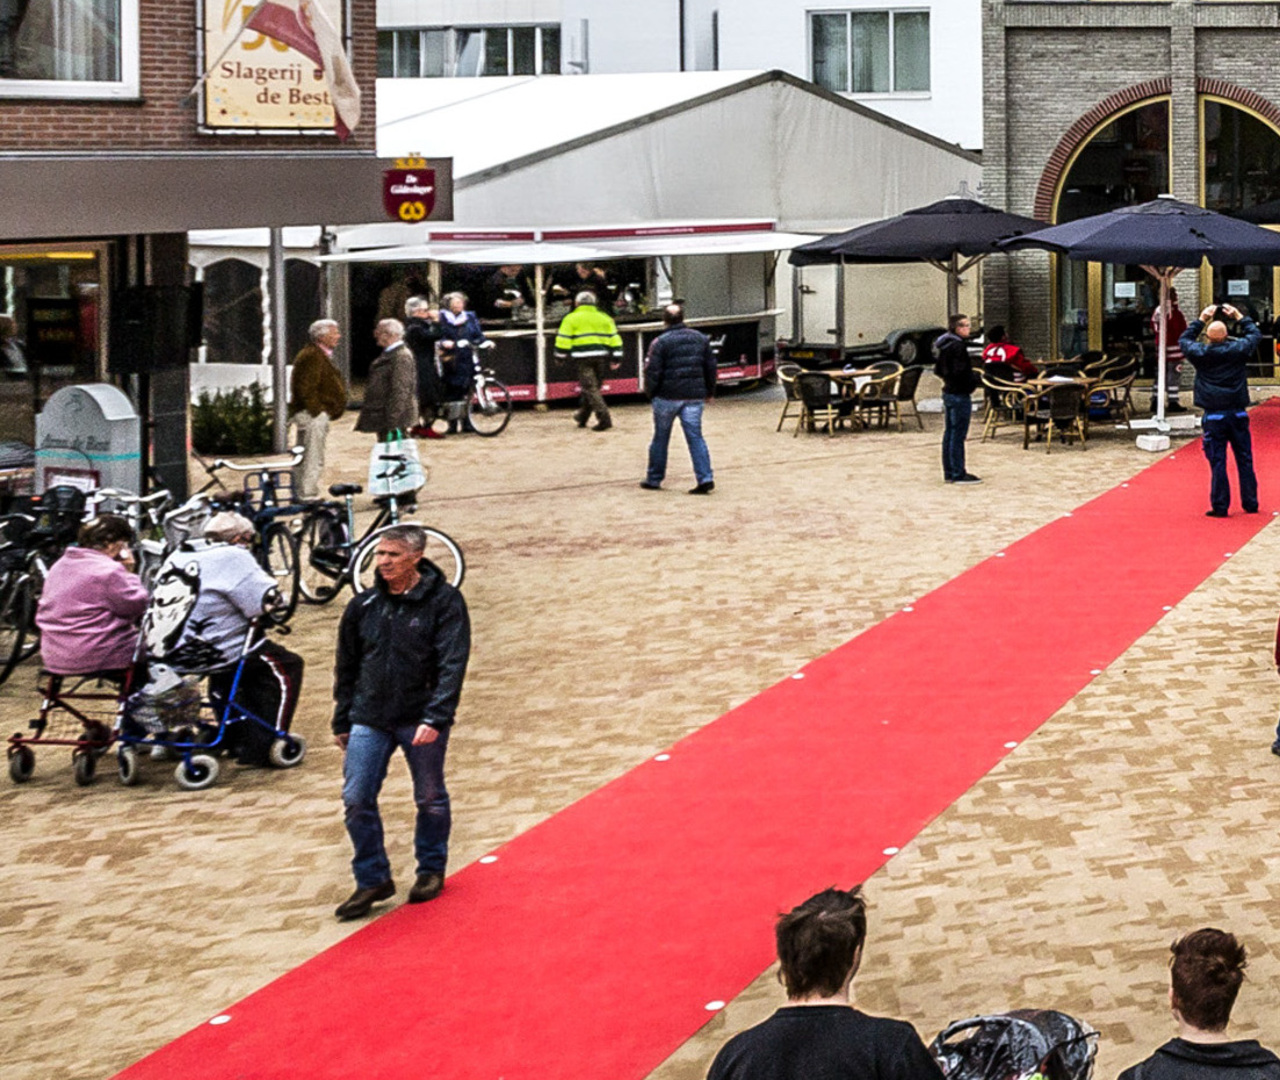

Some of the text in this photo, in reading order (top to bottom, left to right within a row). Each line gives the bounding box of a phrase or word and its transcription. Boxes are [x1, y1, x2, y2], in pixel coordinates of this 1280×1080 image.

[220, 62, 303, 85] Slagerij
[256, 87, 330, 105] de Best
